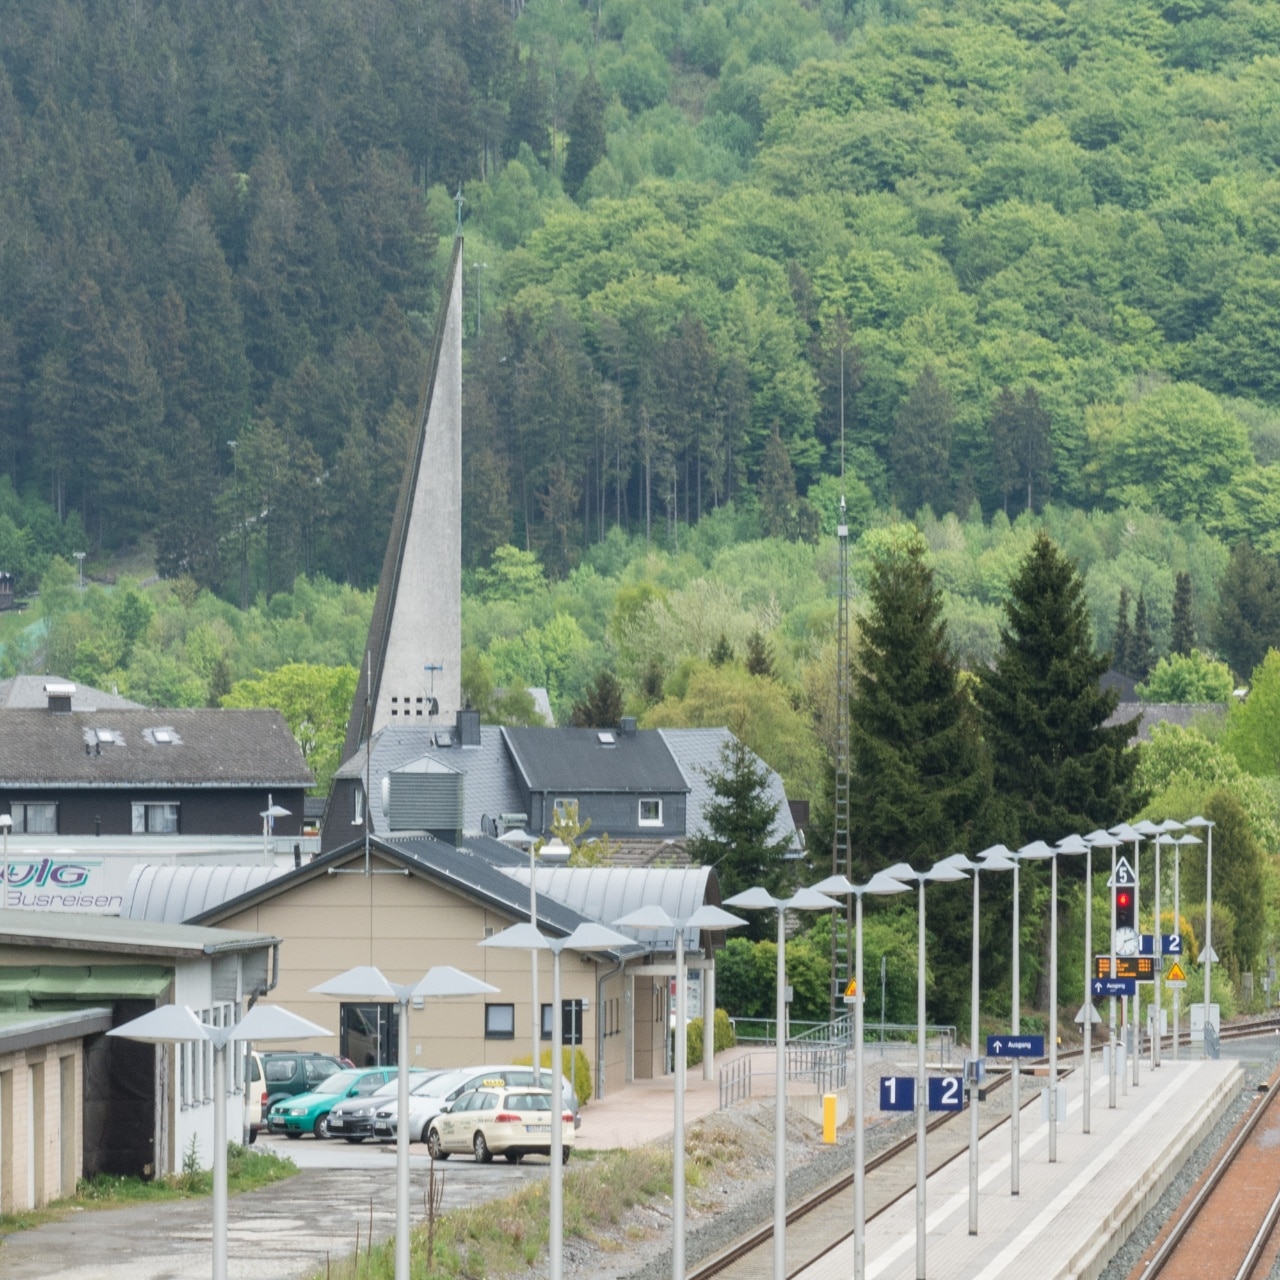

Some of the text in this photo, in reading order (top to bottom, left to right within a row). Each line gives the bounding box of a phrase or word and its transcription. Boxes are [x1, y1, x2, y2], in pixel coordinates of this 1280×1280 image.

[1119, 867, 1128, 883] 5
[7, 890, 123, 908] Busreisen
[1169, 934, 1180, 951] 2
[1007, 1041, 1032, 1049] Ausgang
[884, 1077, 896, 1104] 1
[941, 1077, 959, 1104] 2
